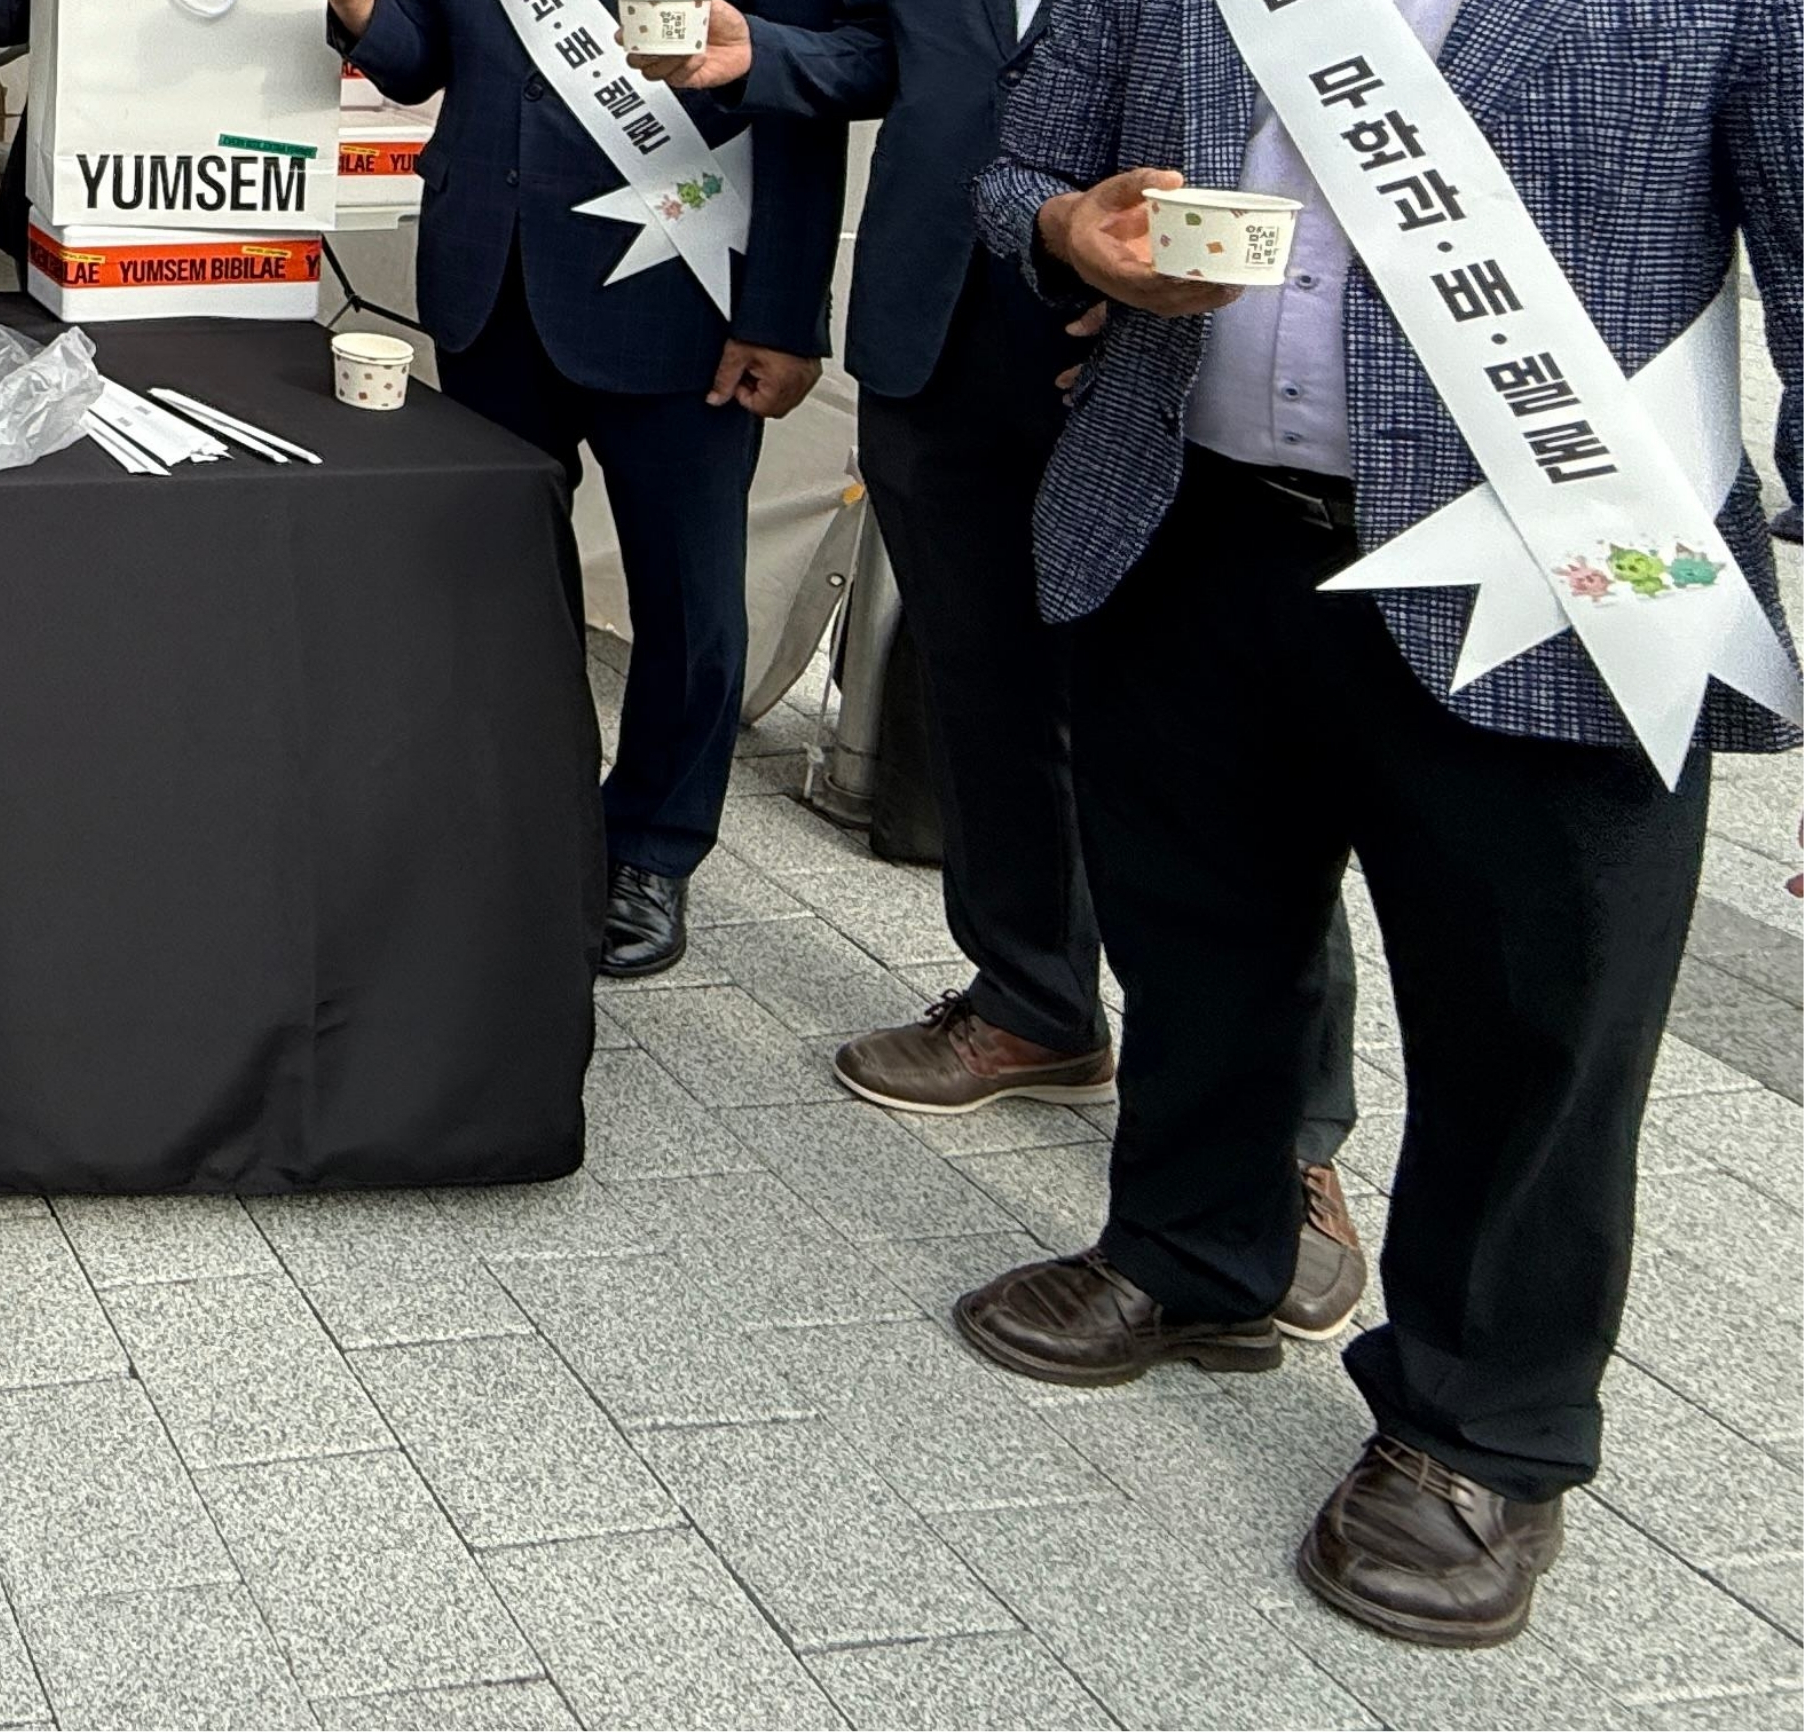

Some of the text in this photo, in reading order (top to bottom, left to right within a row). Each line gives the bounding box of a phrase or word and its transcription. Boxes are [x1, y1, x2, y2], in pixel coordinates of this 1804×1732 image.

[78, 154, 307, 213] YUMSEM
[120, 256, 286, 282] YUMSEM BIBILAE
